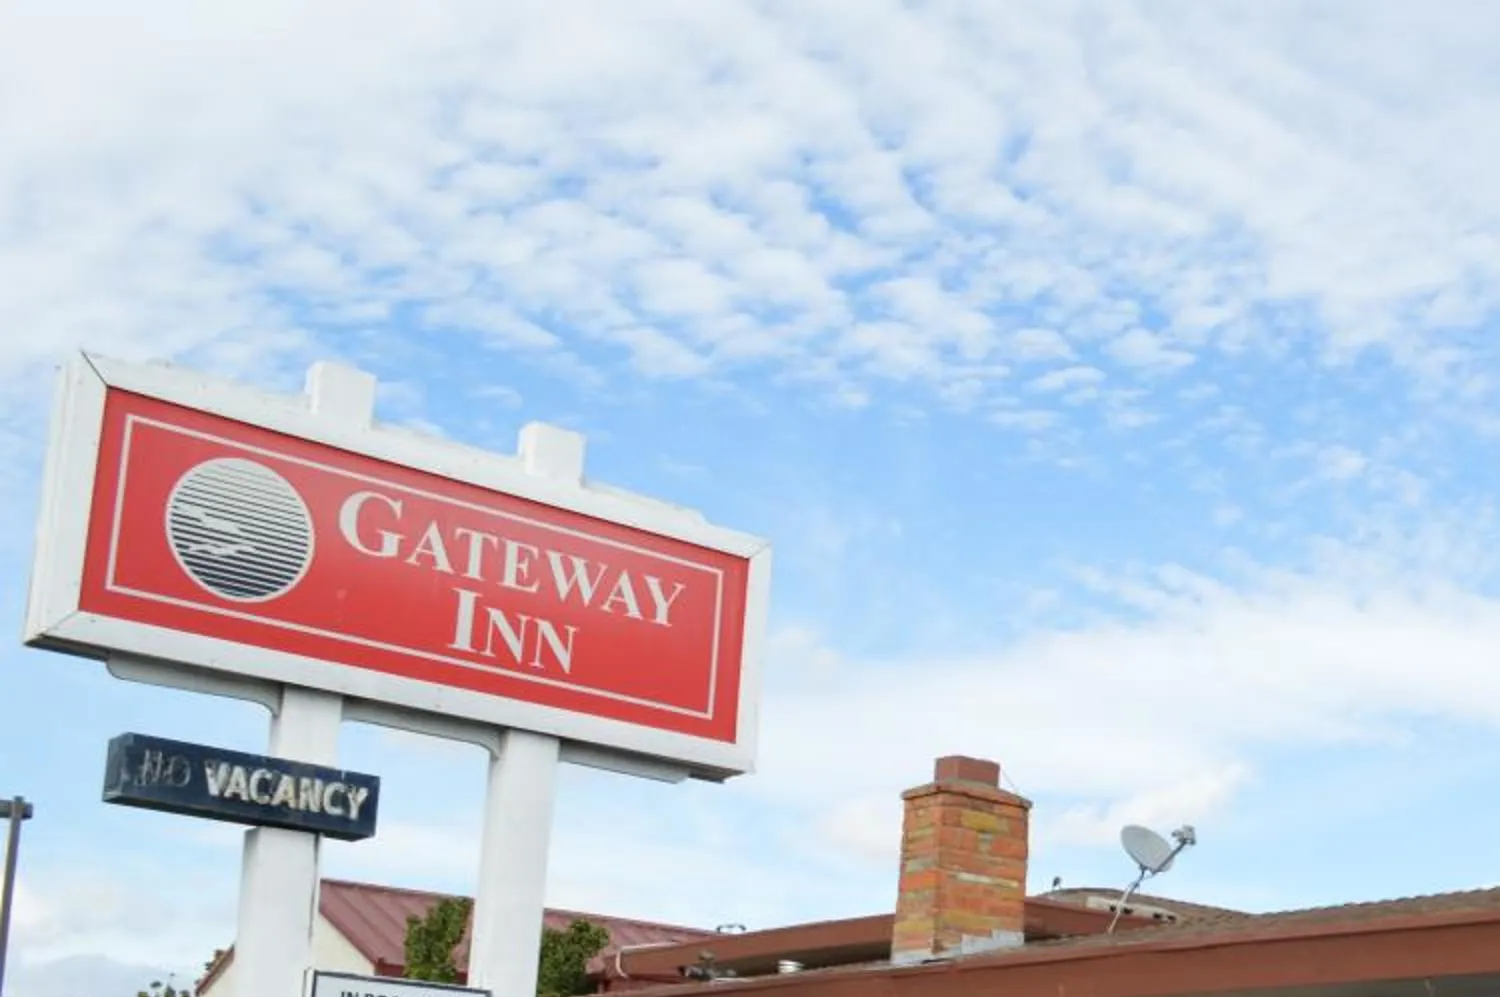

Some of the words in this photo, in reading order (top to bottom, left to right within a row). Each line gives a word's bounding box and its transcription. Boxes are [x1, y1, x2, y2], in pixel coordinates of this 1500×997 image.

[337, 489, 686, 627] GATEWAY
[448, 588, 580, 675] INN
[204, 760, 369, 821] VACANCY
